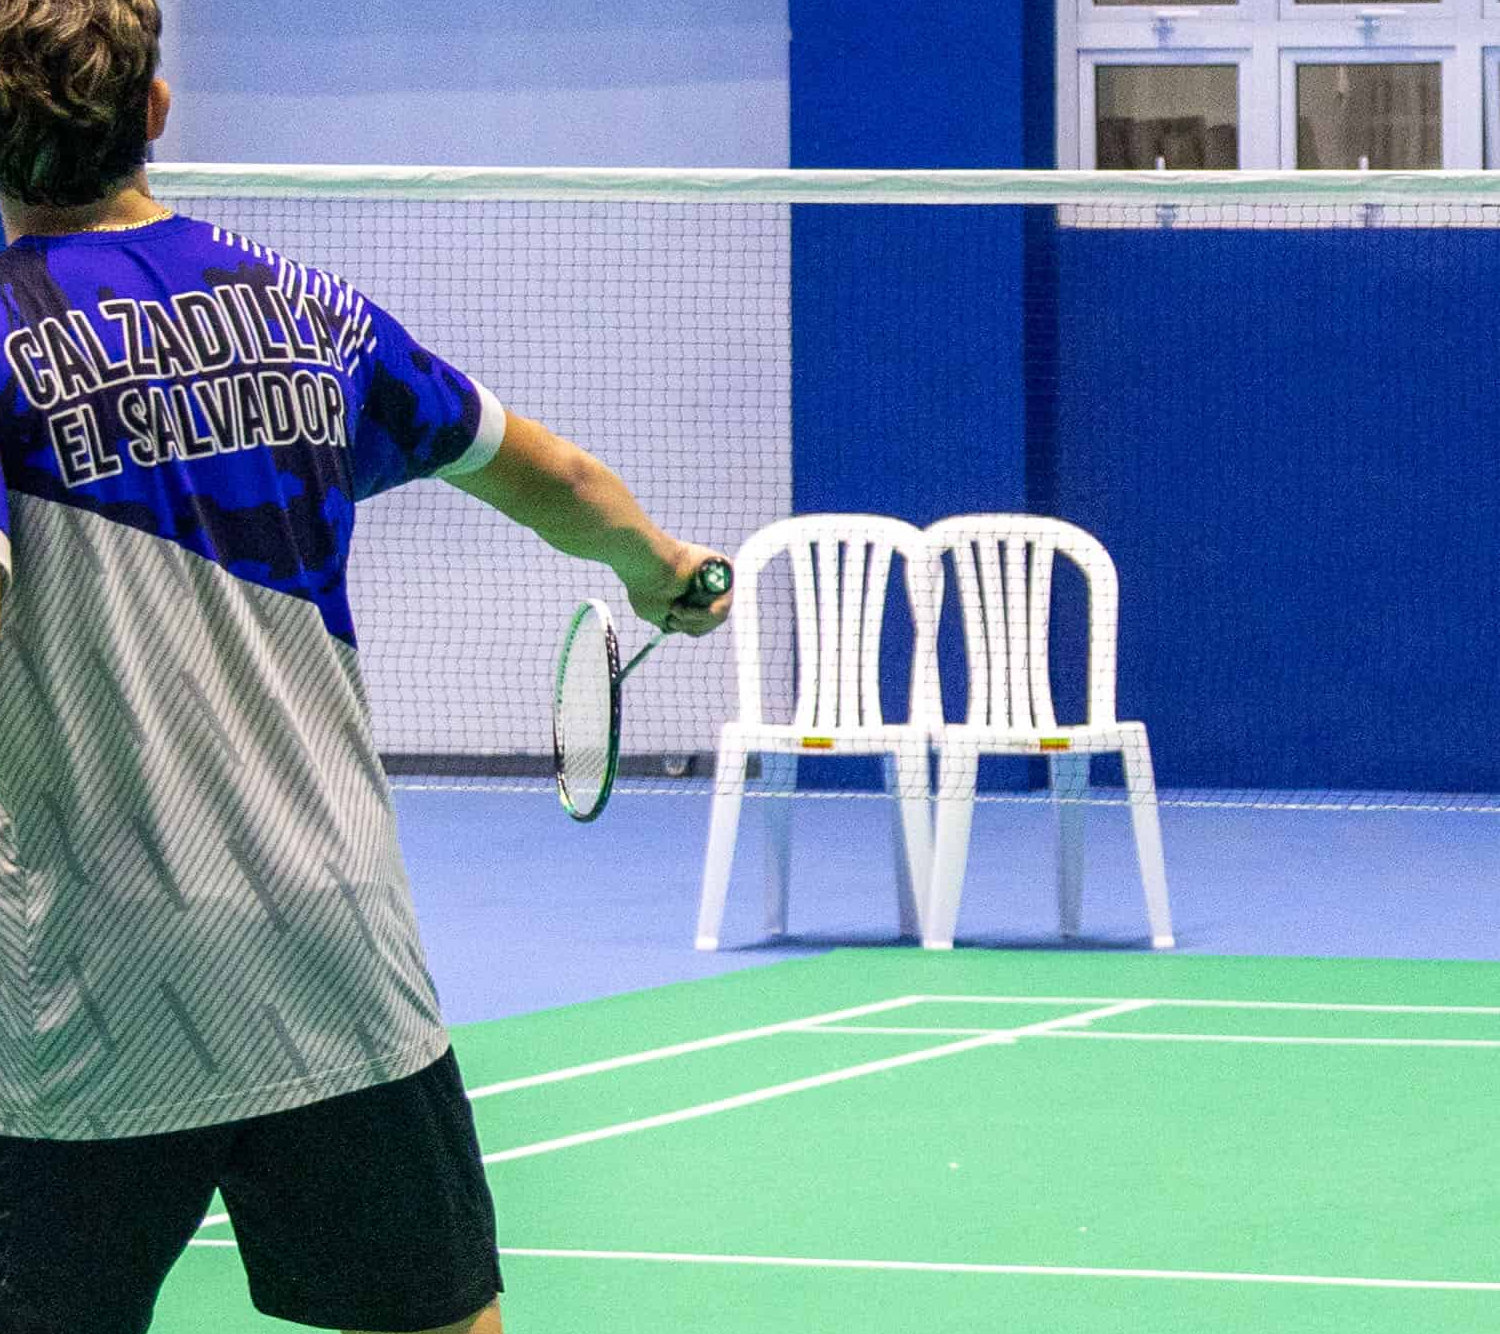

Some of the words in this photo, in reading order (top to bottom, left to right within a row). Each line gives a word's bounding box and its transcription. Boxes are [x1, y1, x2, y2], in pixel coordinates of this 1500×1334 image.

[4, 284, 343, 410] CALZADILLA
[49, 403, 122, 488] EL
[118, 371, 346, 467] SALVADOR
